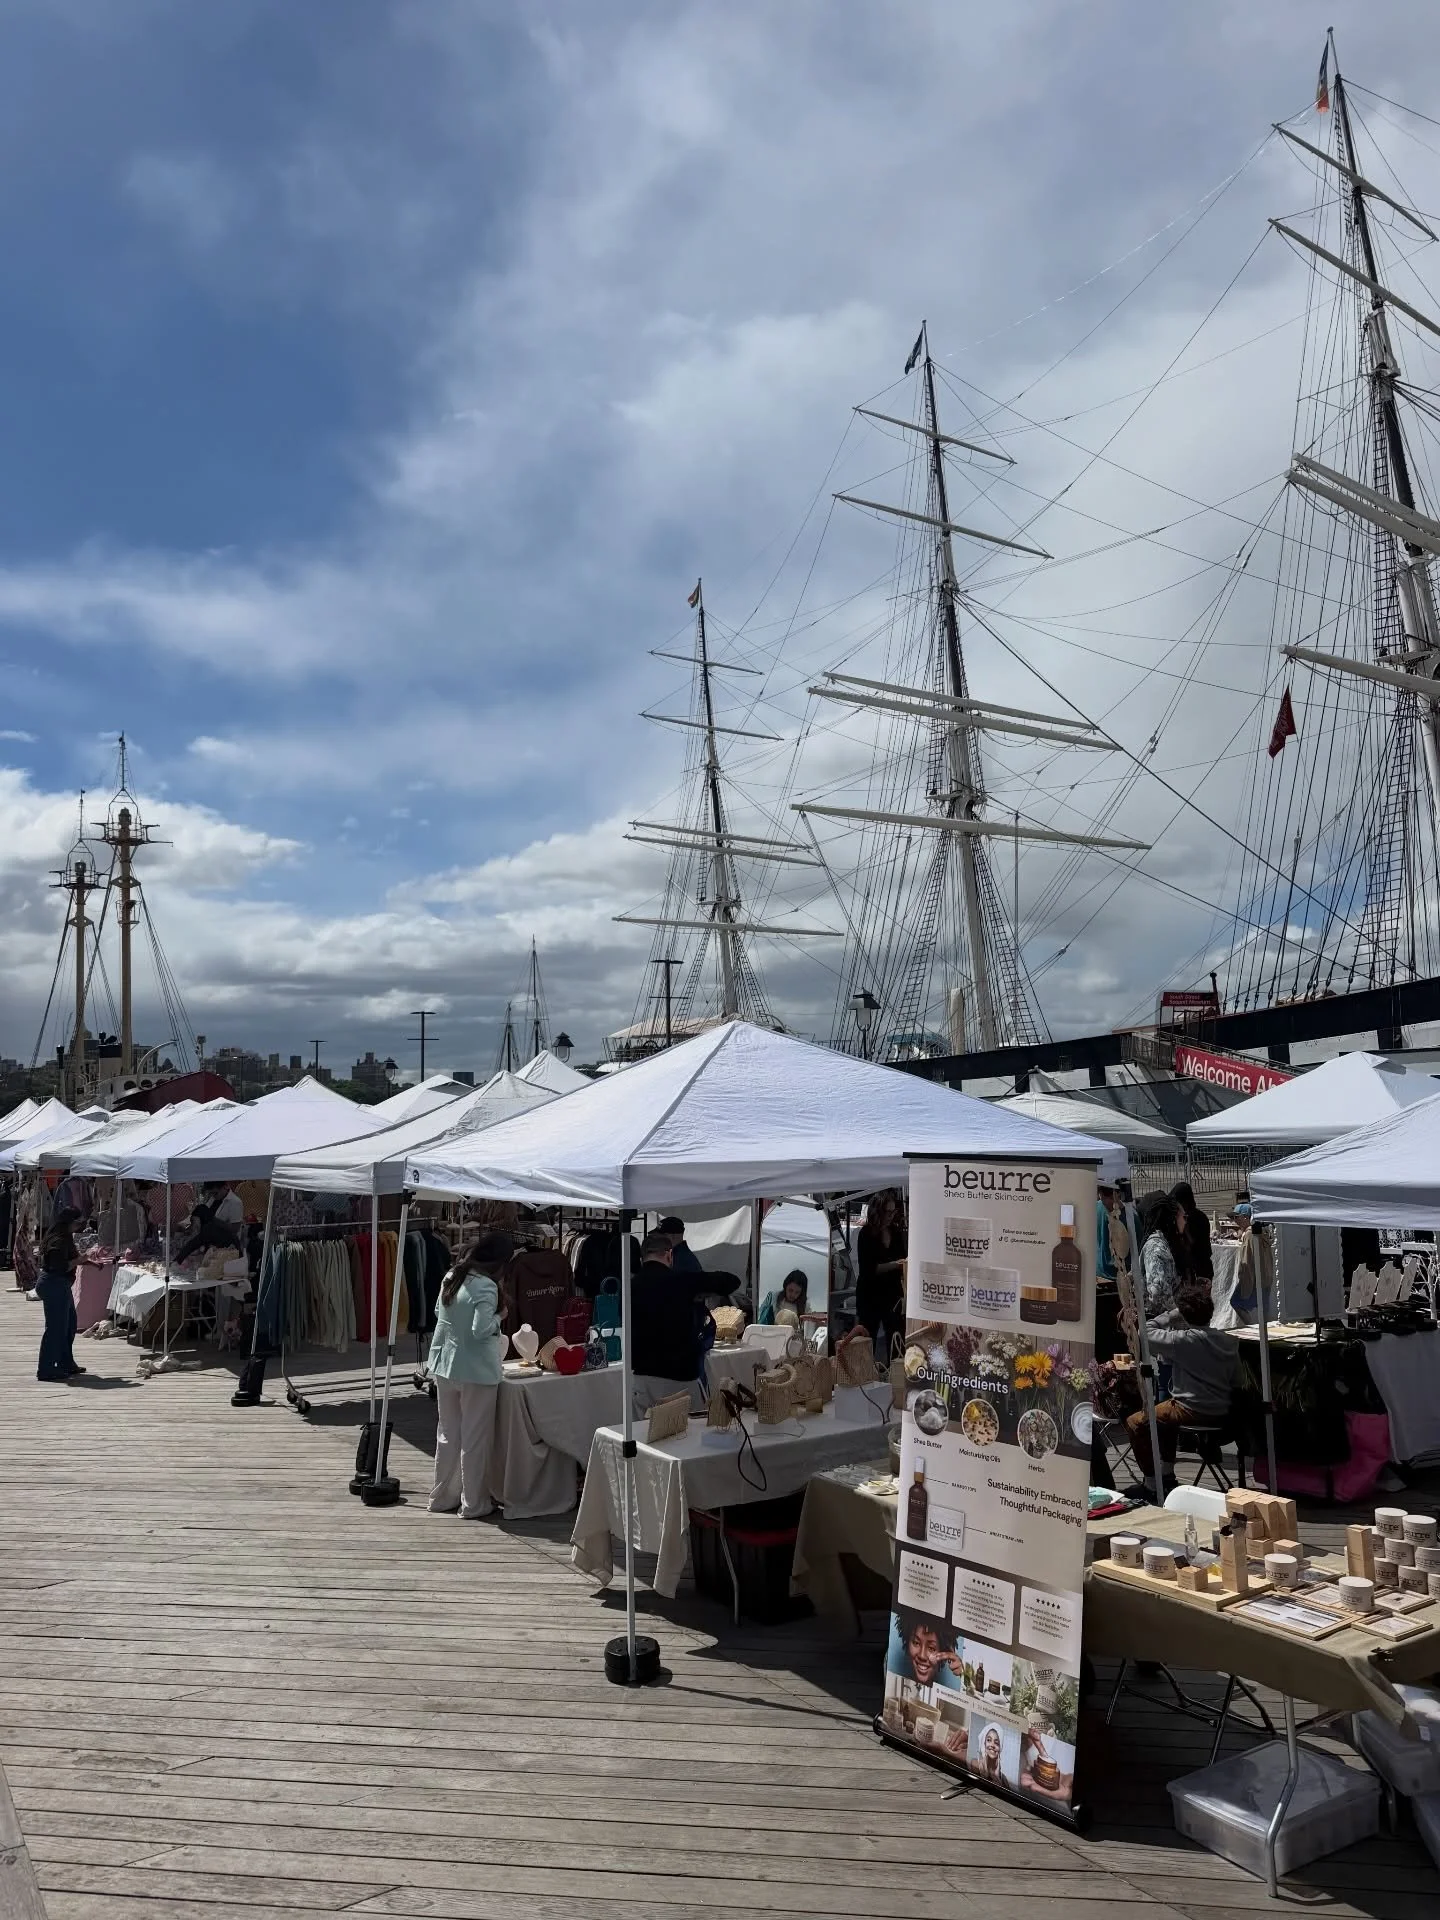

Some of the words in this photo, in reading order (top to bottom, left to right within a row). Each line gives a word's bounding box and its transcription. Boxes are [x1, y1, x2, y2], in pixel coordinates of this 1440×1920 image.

[1182, 1054, 1251, 1093] Welcome
[944, 1165, 1051, 1194] beurre
[944, 1190, 965, 1198] Shea
[967, 1191, 992, 1200] Butter
[995, 1193, 1034, 1202] Skincare
[945, 1233, 990, 1250] beurre
[922, 1280, 965, 1296] beurre
[971, 1285, 1016, 1303] beurre
[917, 1367, 938, 1381] Our
[939, 1371, 1009, 1394] Ingredients
[913, 1437, 926, 1446] Shea
[926, 1439, 942, 1449] Butter
[958, 1448, 990, 1463] Moisturizing
[990, 1455, 1001, 1463] Oils
[1028, 1463, 1045, 1473] Herbs
[987, 1478, 1039, 1500] Sustainability
[1040, 1490, 1083, 1510] Embraced,
[999, 1496, 1041, 1515] Thoughtful
[1042, 1507, 1082, 1527] Packaging
[929, 1518, 961, 1537] beurre
